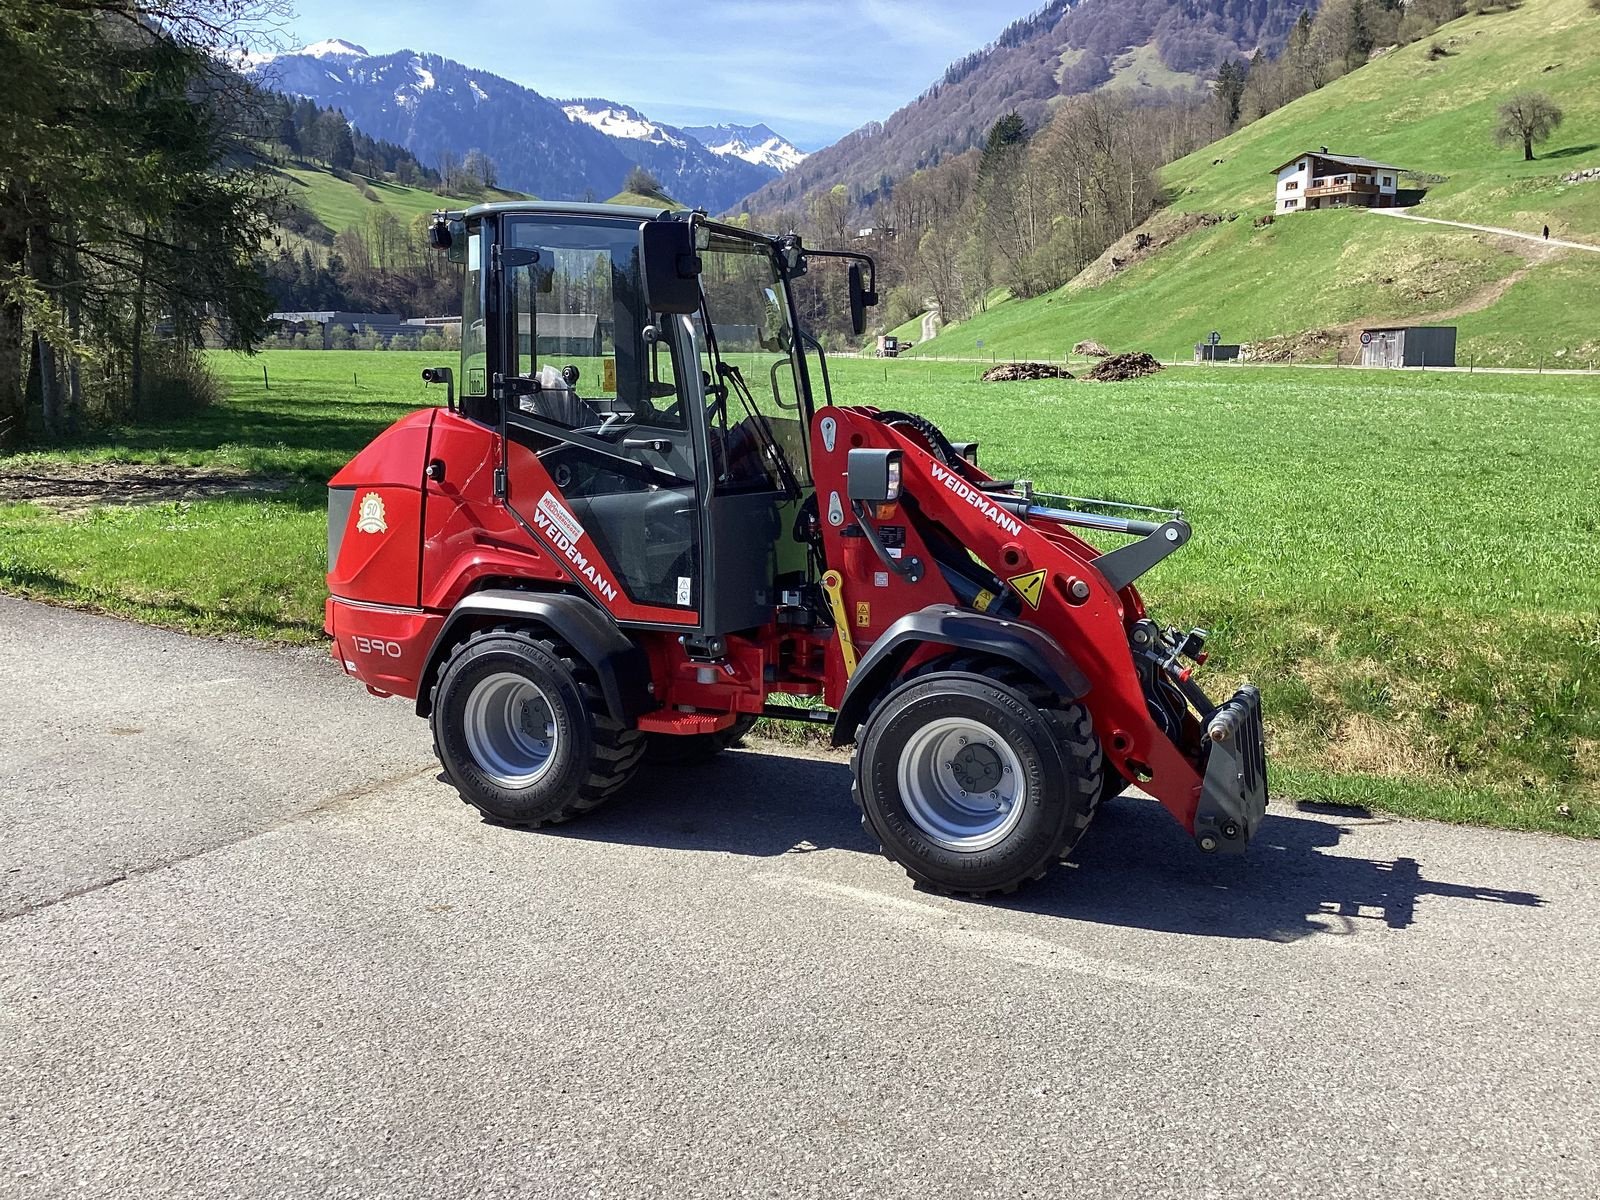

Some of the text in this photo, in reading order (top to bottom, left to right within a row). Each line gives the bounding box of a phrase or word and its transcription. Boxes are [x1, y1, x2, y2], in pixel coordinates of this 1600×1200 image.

[366, 503, 378, 516] 50
[931, 463, 1022, 537] WEIDEMANN
[533, 508, 618, 602] WEIDEMANN
[351, 635, 402, 658] 1390
